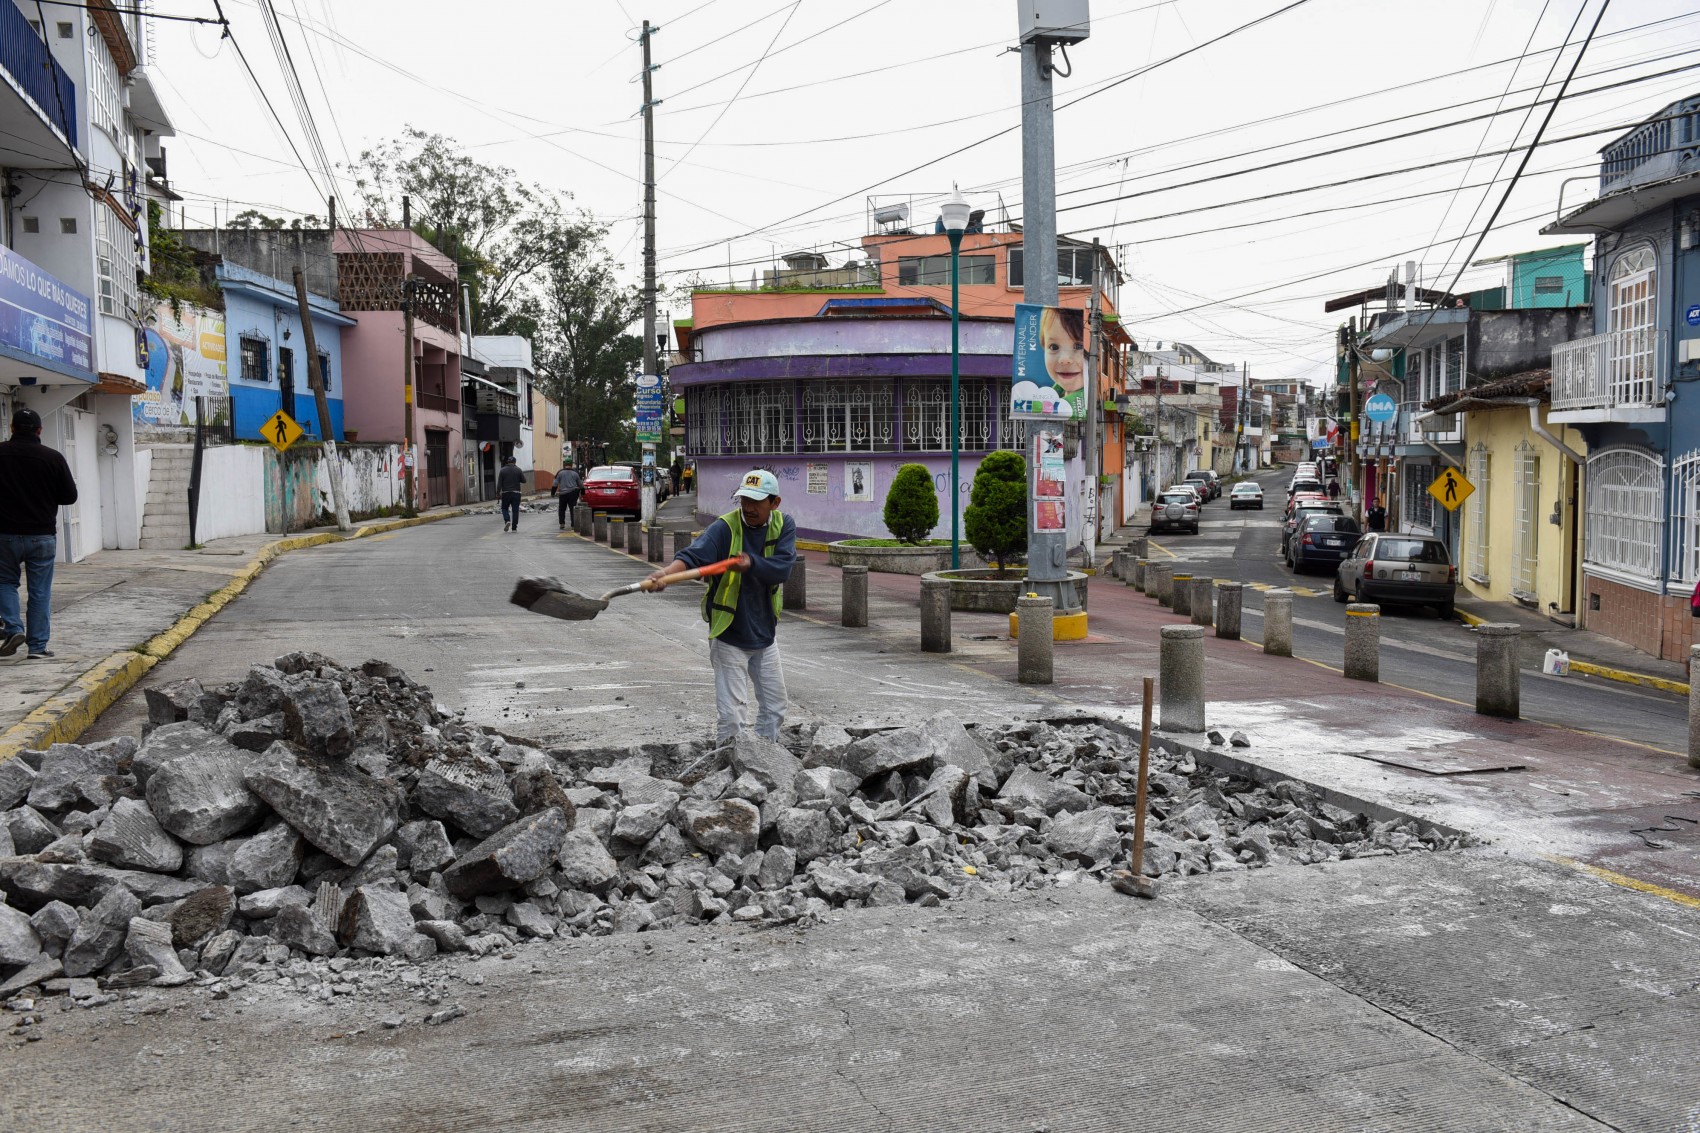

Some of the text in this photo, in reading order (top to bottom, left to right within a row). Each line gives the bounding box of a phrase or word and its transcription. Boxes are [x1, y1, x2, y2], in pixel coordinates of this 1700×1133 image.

[26, 270, 36, 292] LO
[38, 276, 51, 300] QUE
[52, 282, 65, 307] MÁS
[66, 293, 87, 320] QUIERES
[1018, 325, 1026, 376] MATERNAL
[1368, 402, 1394, 411] IMA
[746, 476, 760, 485] CAT
